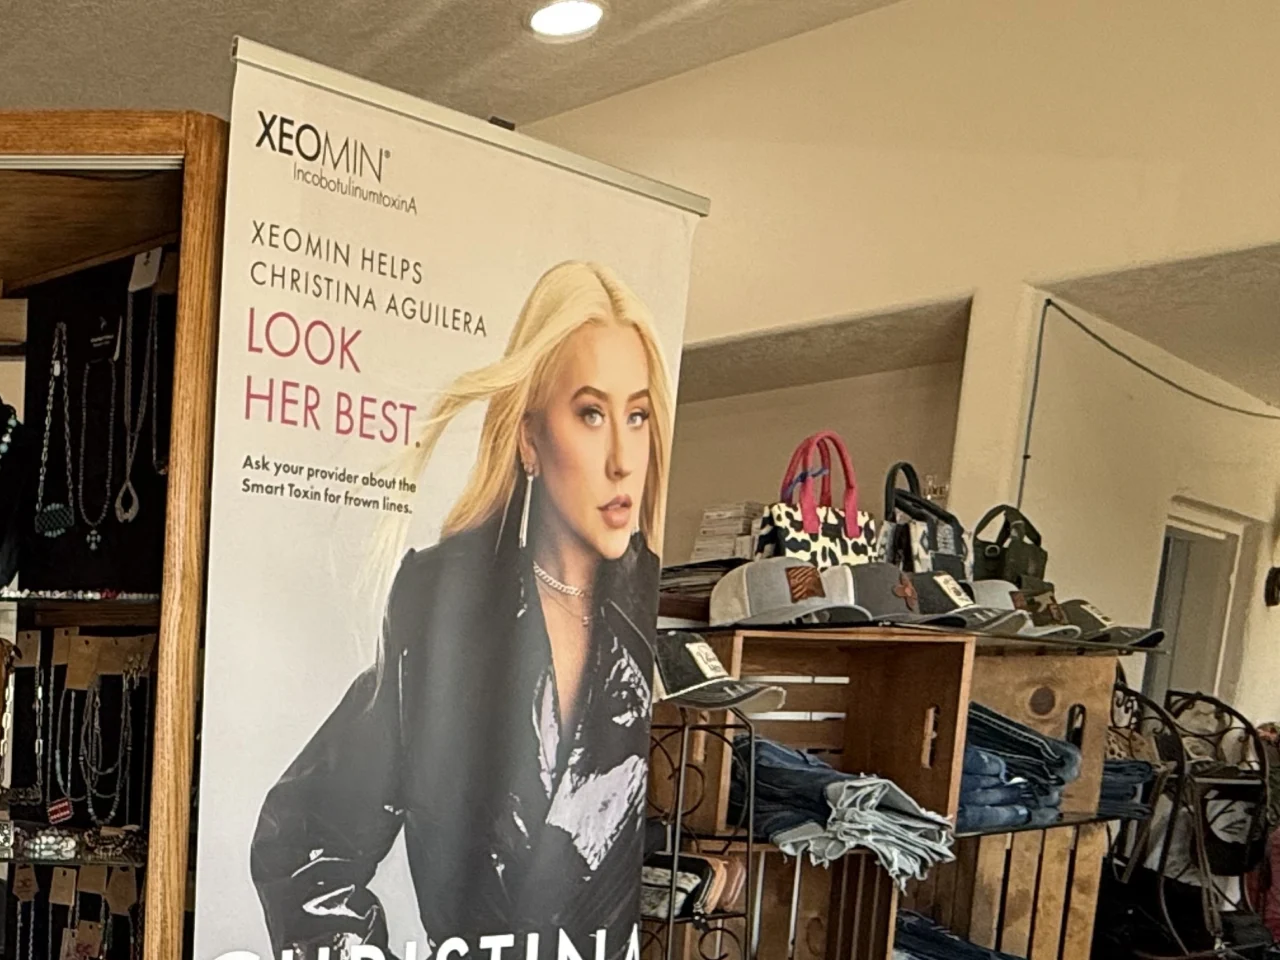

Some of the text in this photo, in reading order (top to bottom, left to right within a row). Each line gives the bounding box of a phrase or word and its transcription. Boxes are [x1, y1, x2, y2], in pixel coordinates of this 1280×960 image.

[293, 162, 418, 215] IncobotulinumtoxinA
[252, 220, 423, 284] XEOMIN HELPS
[250, 261, 487, 337] CHRISTINA AGUILERA
[248, 307, 362, 373] LOOK
[245, 375, 421, 448] HER BEST.
[242, 455, 416, 493] Ask your provider about the
[242, 478, 412, 514] Smart Toxin for frown lines.
